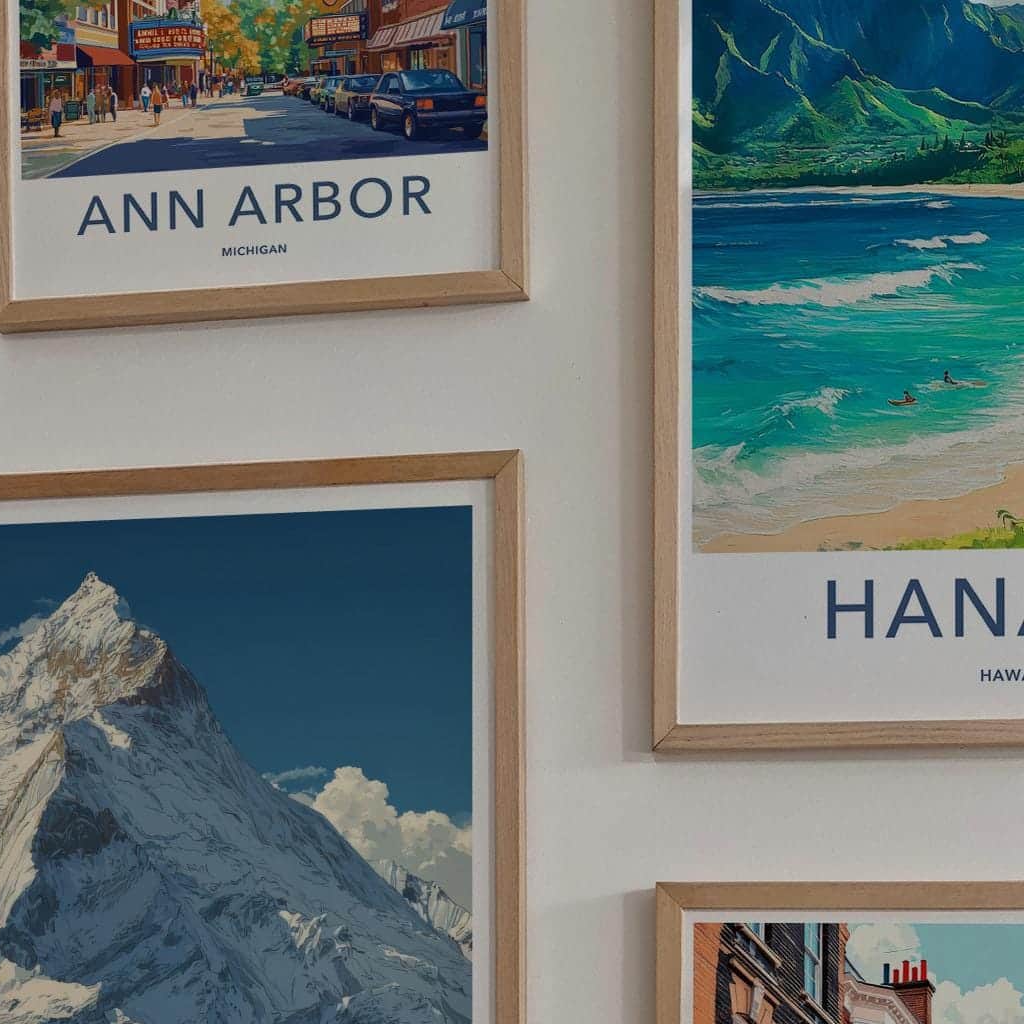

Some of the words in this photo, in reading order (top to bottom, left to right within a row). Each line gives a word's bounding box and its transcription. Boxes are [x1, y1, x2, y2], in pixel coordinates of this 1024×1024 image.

[77, 189, 204, 236] ANN
[228, 175, 432, 227] ARBOR
[221, 243, 287, 257] MICHIGAN
[827, 577, 1024, 639] HAN
[980, 668, 1024, 682] HAW
